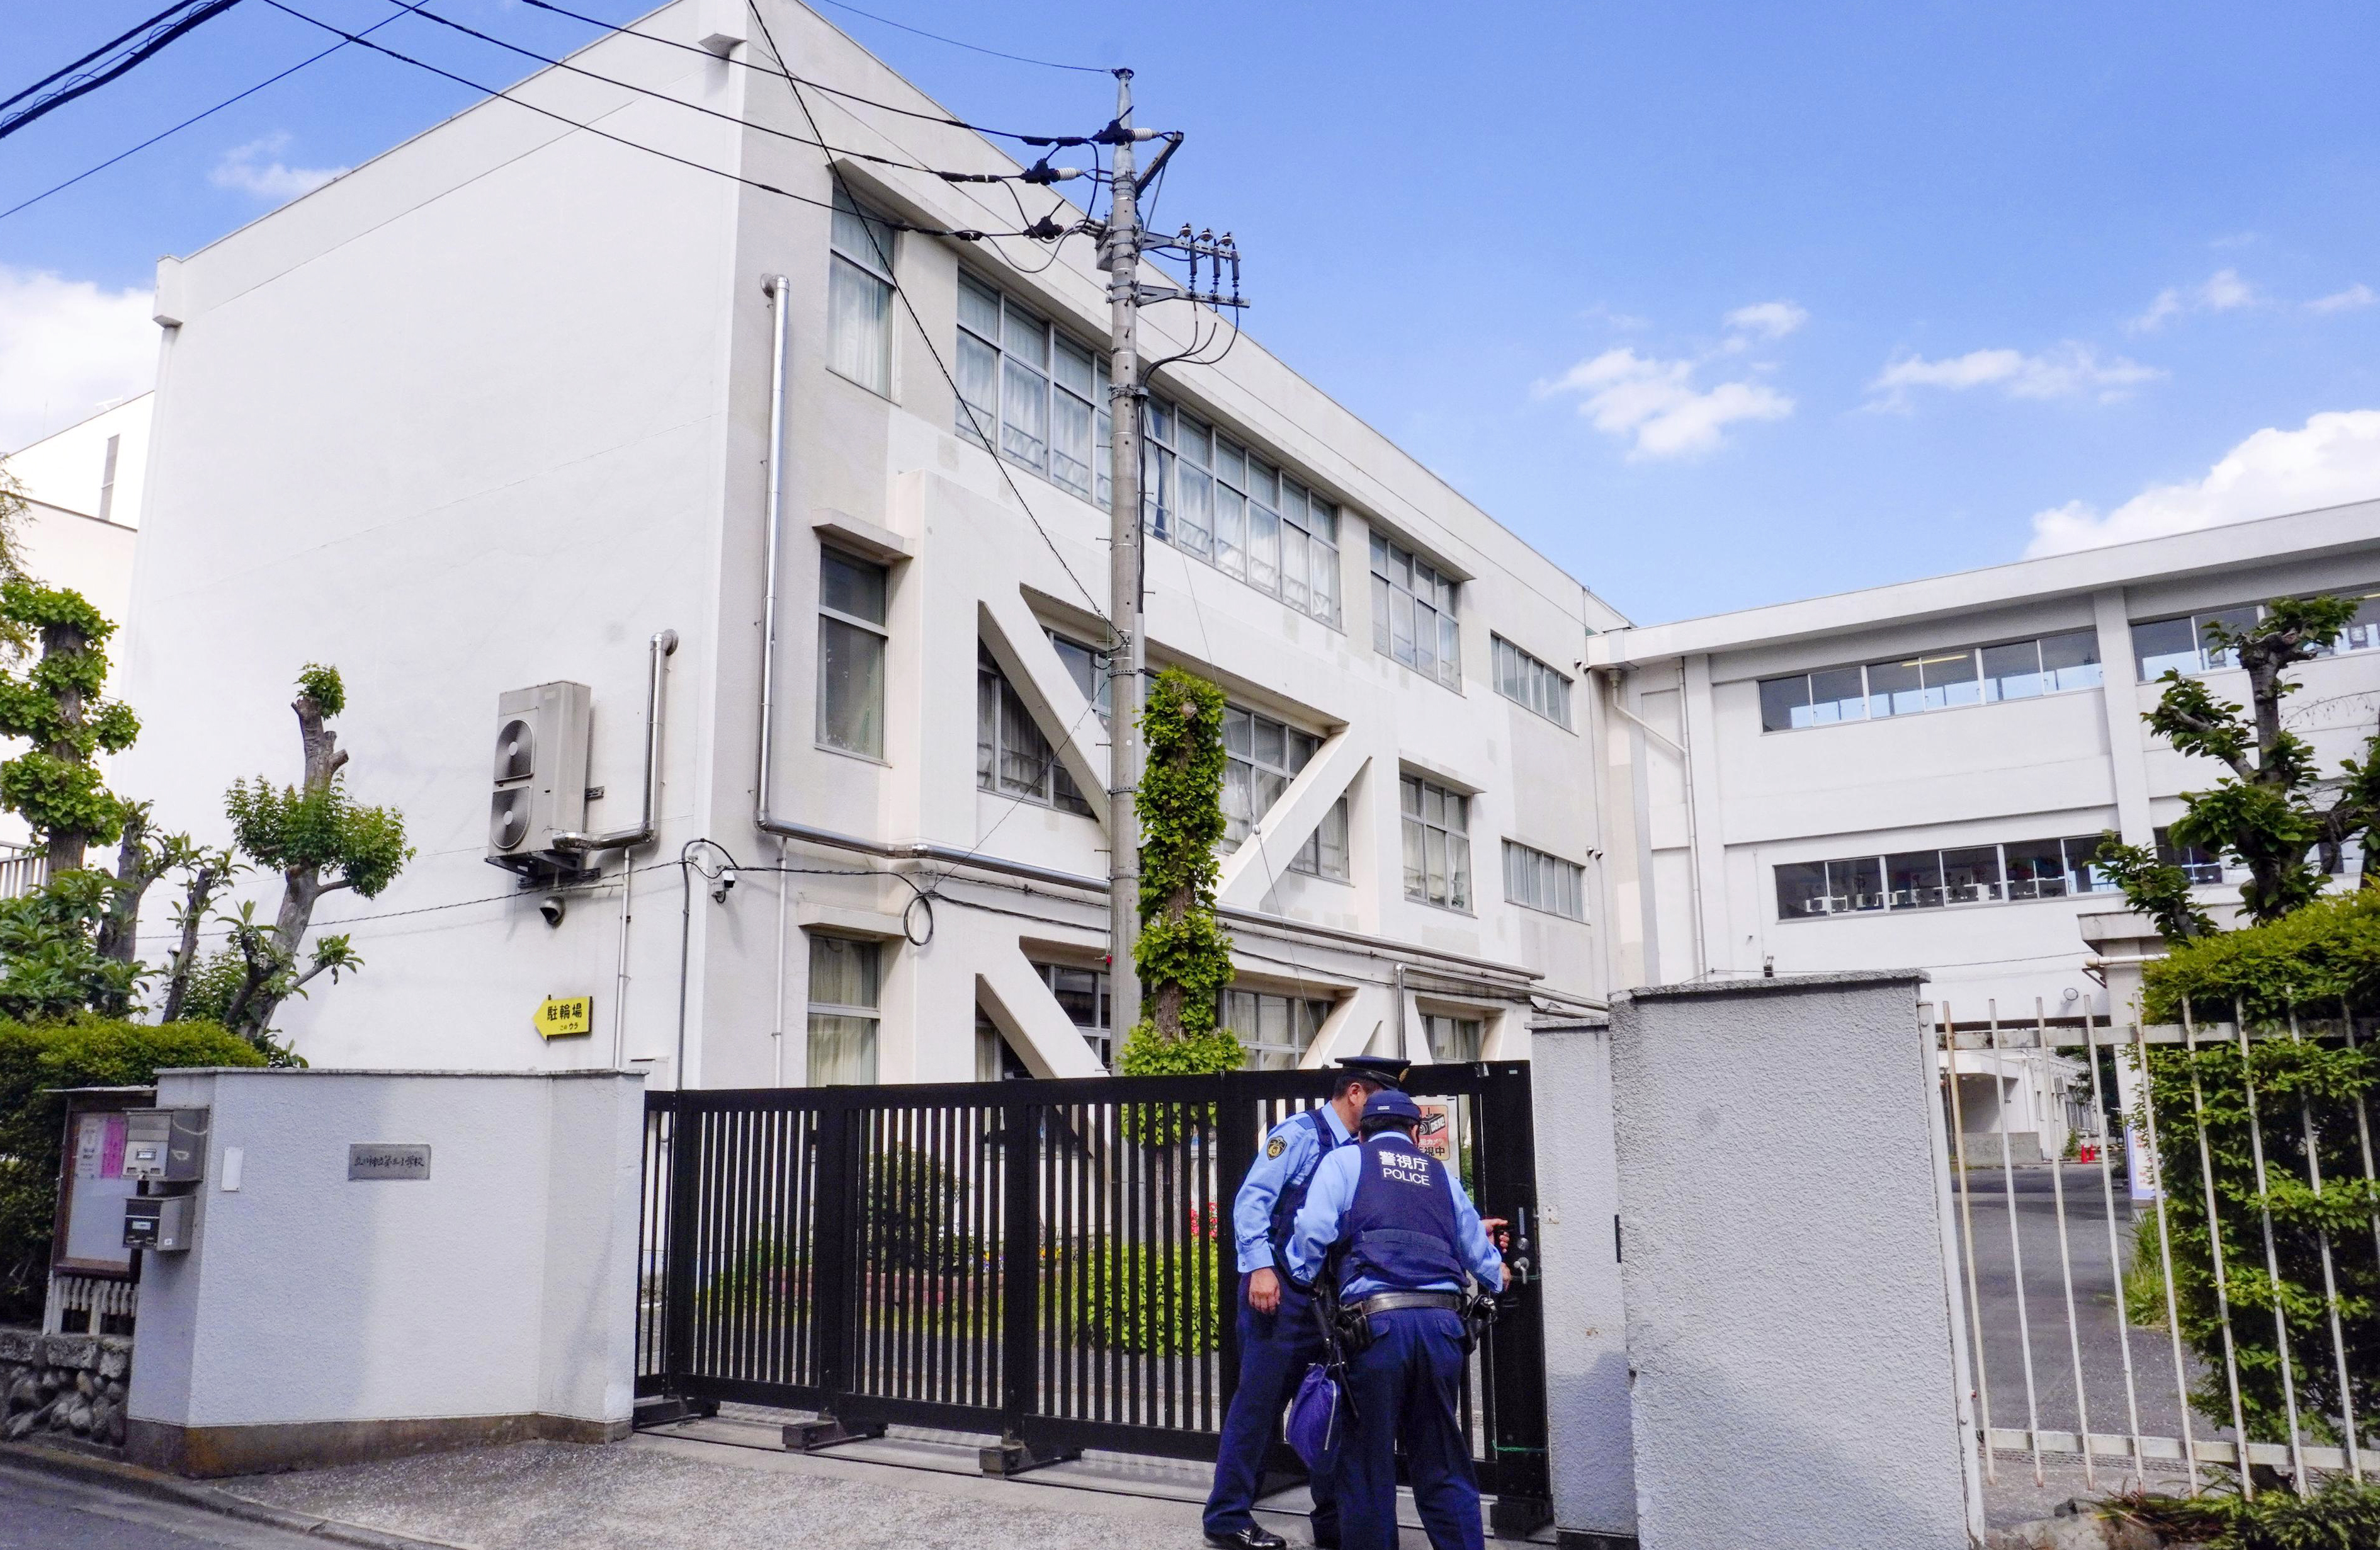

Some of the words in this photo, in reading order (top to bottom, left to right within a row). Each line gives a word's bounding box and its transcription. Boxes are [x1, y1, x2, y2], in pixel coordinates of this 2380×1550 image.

[547, 1003, 582, 1021] 駐輪場
[1379, 1151, 1429, 1171] 警視庁
[1383, 1168, 1430, 1186] POLICE
